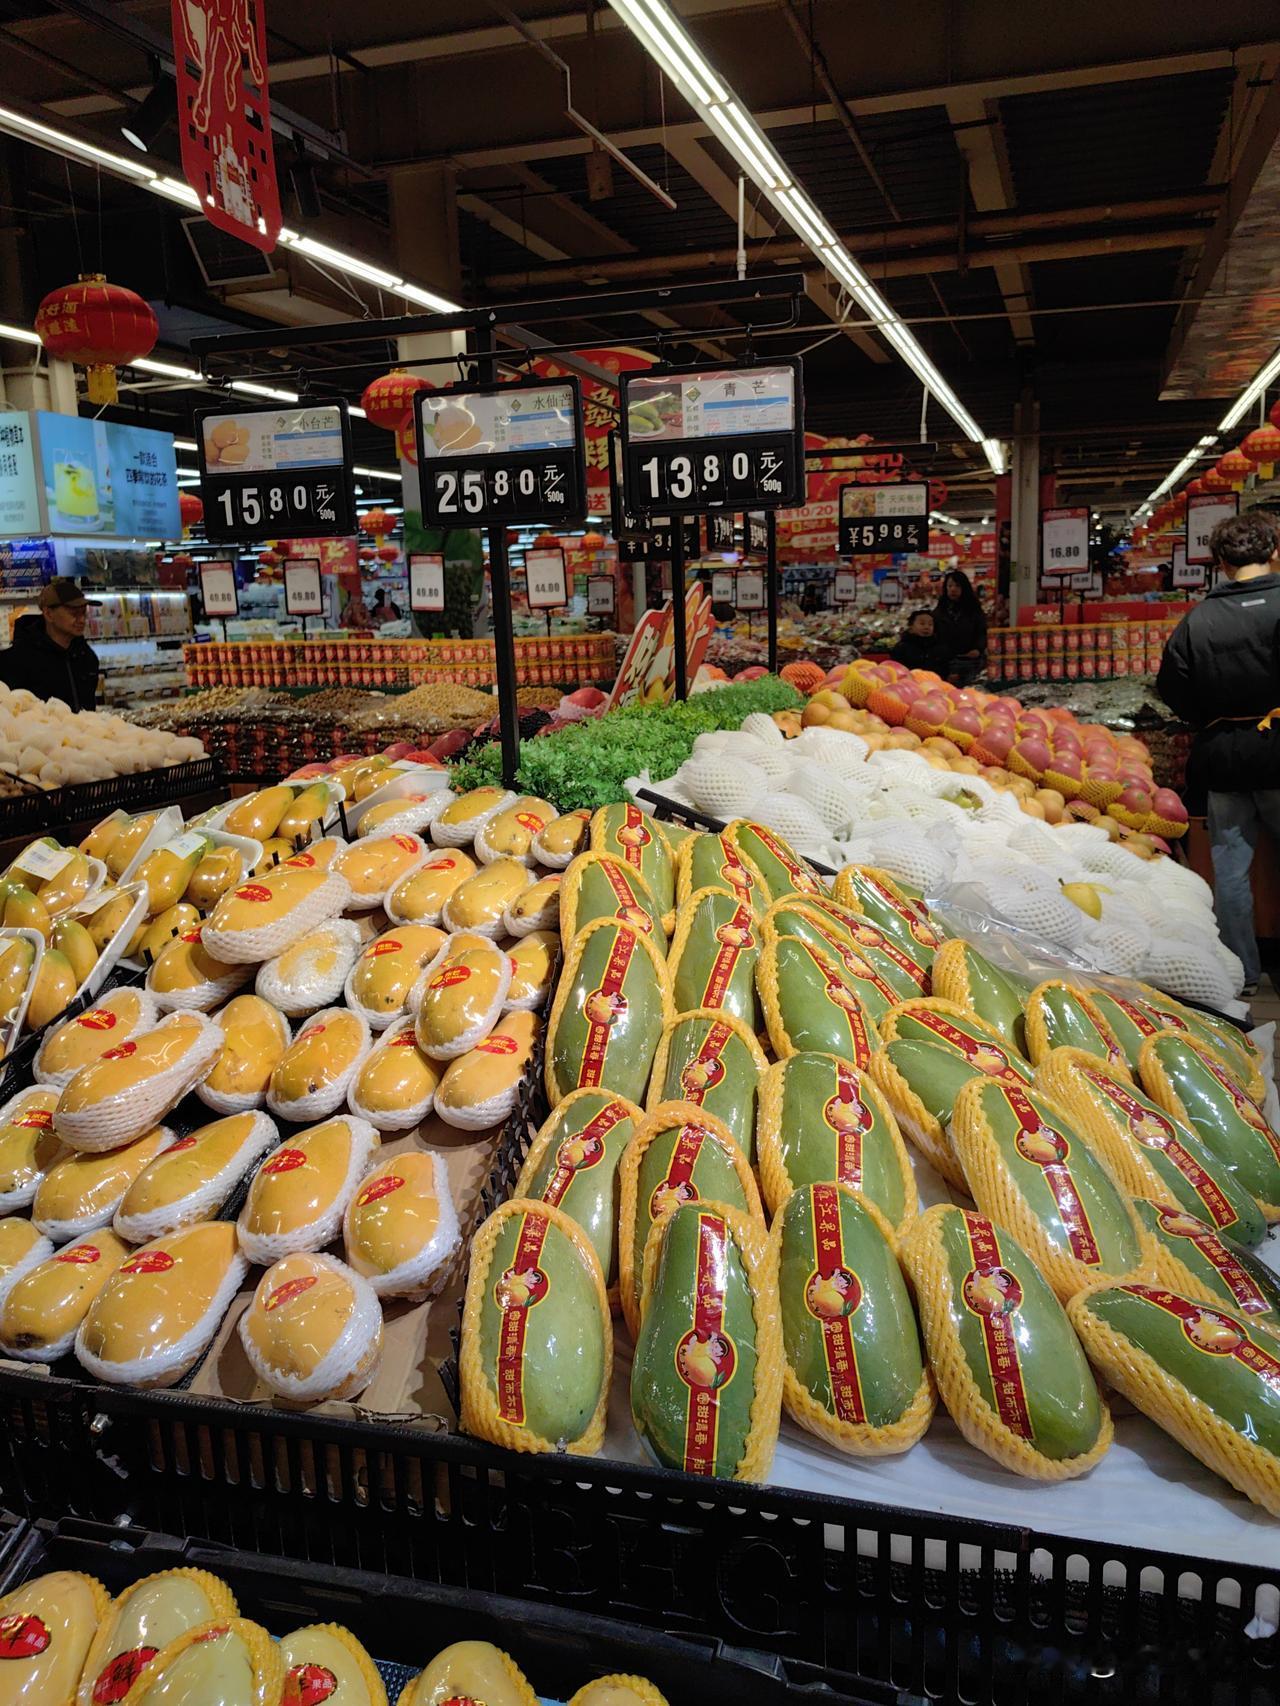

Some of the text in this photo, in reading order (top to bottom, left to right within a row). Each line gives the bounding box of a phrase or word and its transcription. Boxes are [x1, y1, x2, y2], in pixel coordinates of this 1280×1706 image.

[534, 393, 571, 410] 水仙芒
[300, 416, 334, 430] 小台芒
[642, 452, 749, 498] 13.80
[436, 469, 535, 513] 25.80
[217, 486, 307, 526] 15.80
[1050, 546, 1080, 558] 16.80
